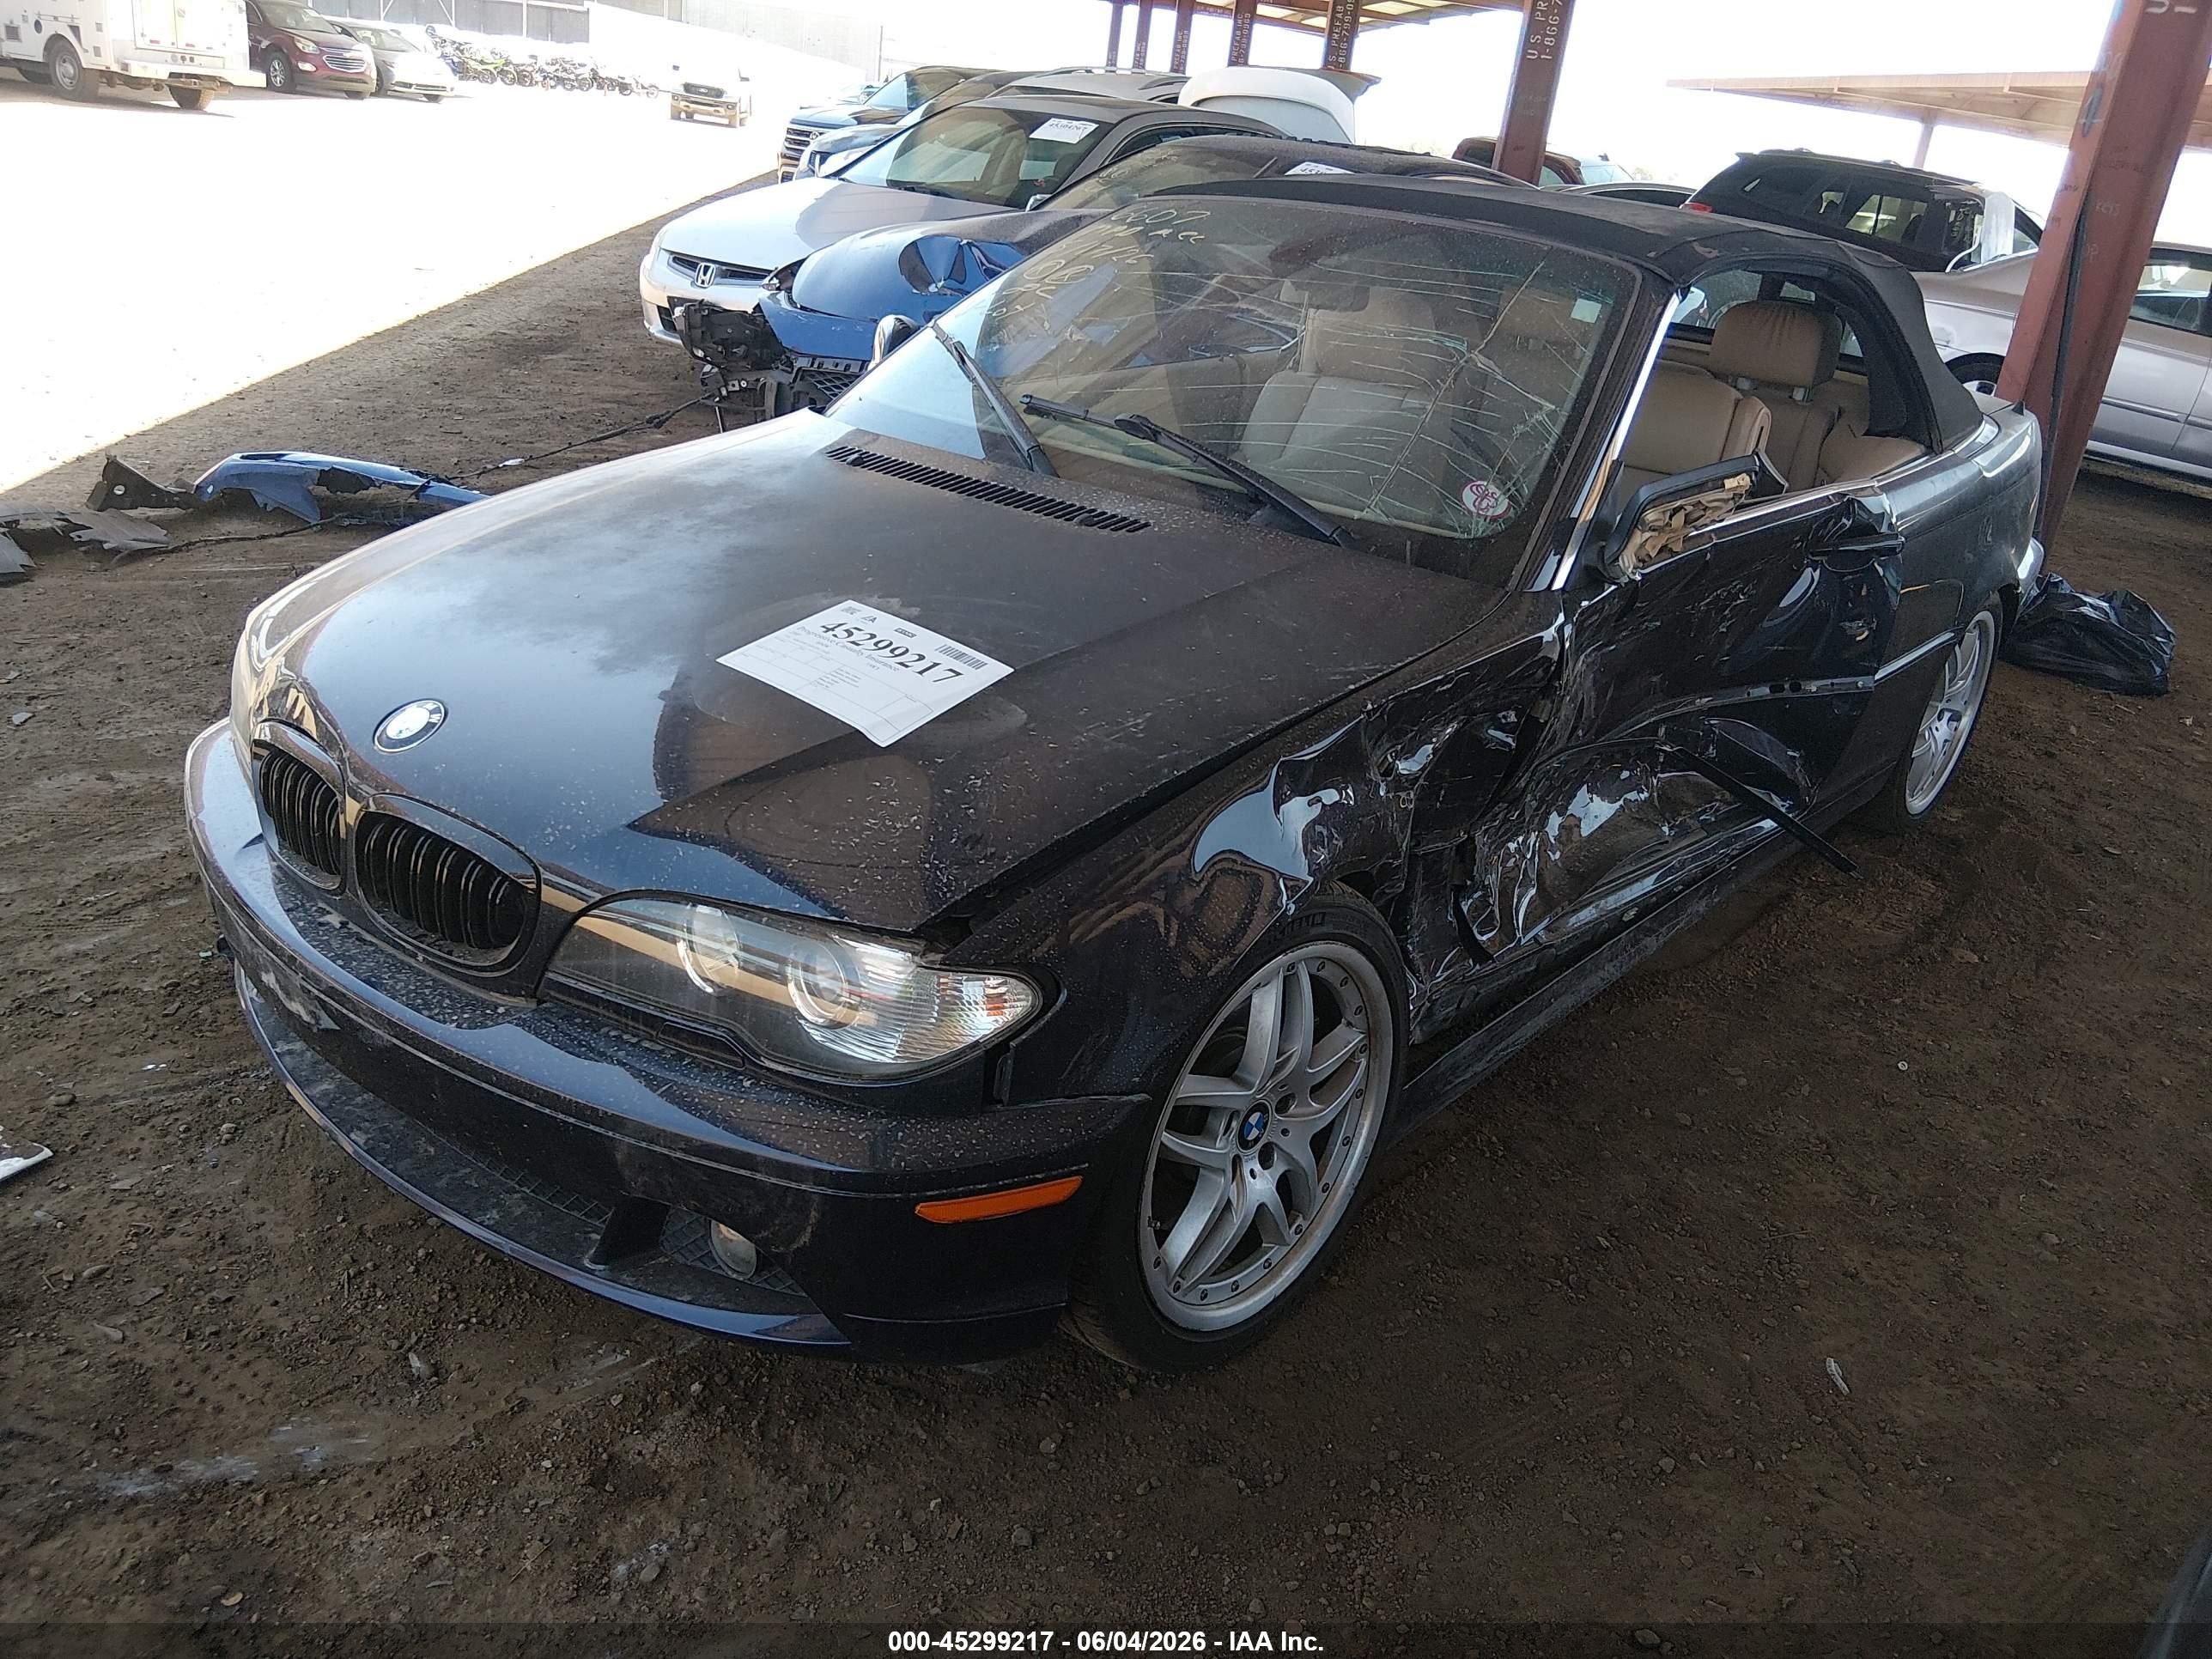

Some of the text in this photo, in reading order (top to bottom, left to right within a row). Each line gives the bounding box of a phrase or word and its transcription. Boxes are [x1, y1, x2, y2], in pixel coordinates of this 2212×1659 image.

[1231, 30, 1242, 61] PREFAB
[1332, 5, 1345, 46] PREFAB
[820, 622, 964, 684] 45299217
